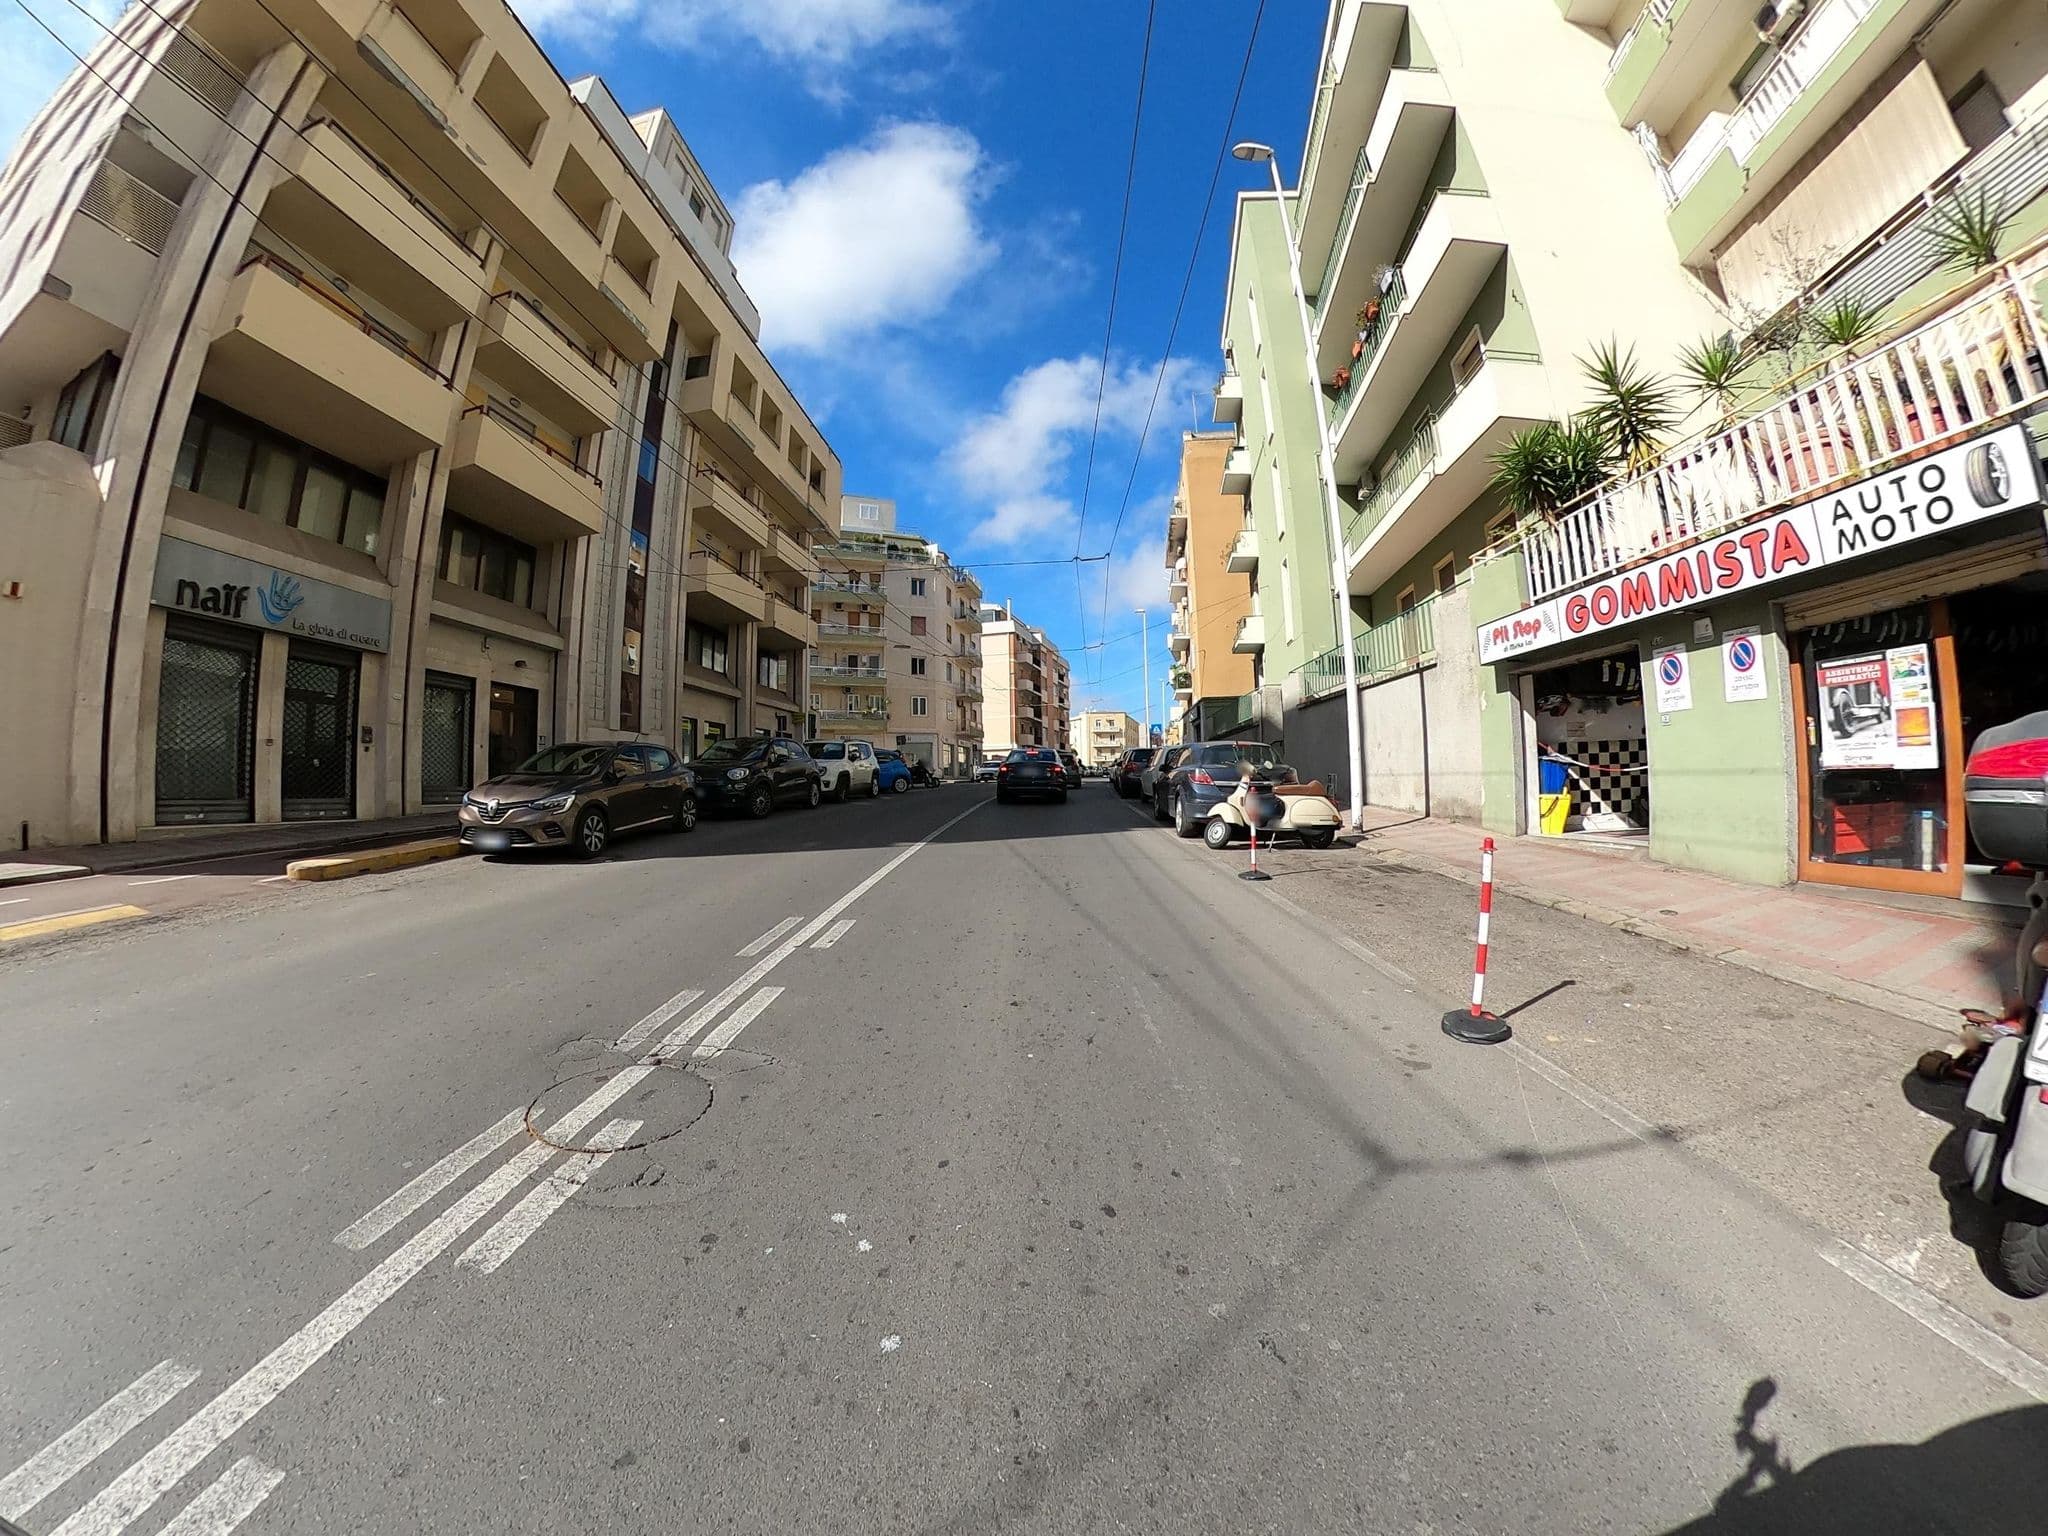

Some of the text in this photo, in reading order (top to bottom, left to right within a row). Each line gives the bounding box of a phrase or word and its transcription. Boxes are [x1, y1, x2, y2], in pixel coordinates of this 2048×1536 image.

[1832, 464, 1945, 526] AUTO
[1838, 495, 1953, 554] MOTO
[176, 579, 250, 618] naïf
[1566, 520, 1809, 633] GOMMISTA
[292, 617, 305, 631] La
[337, 628, 347, 639] di
[1492, 618, 1541, 646] Pit Stop
